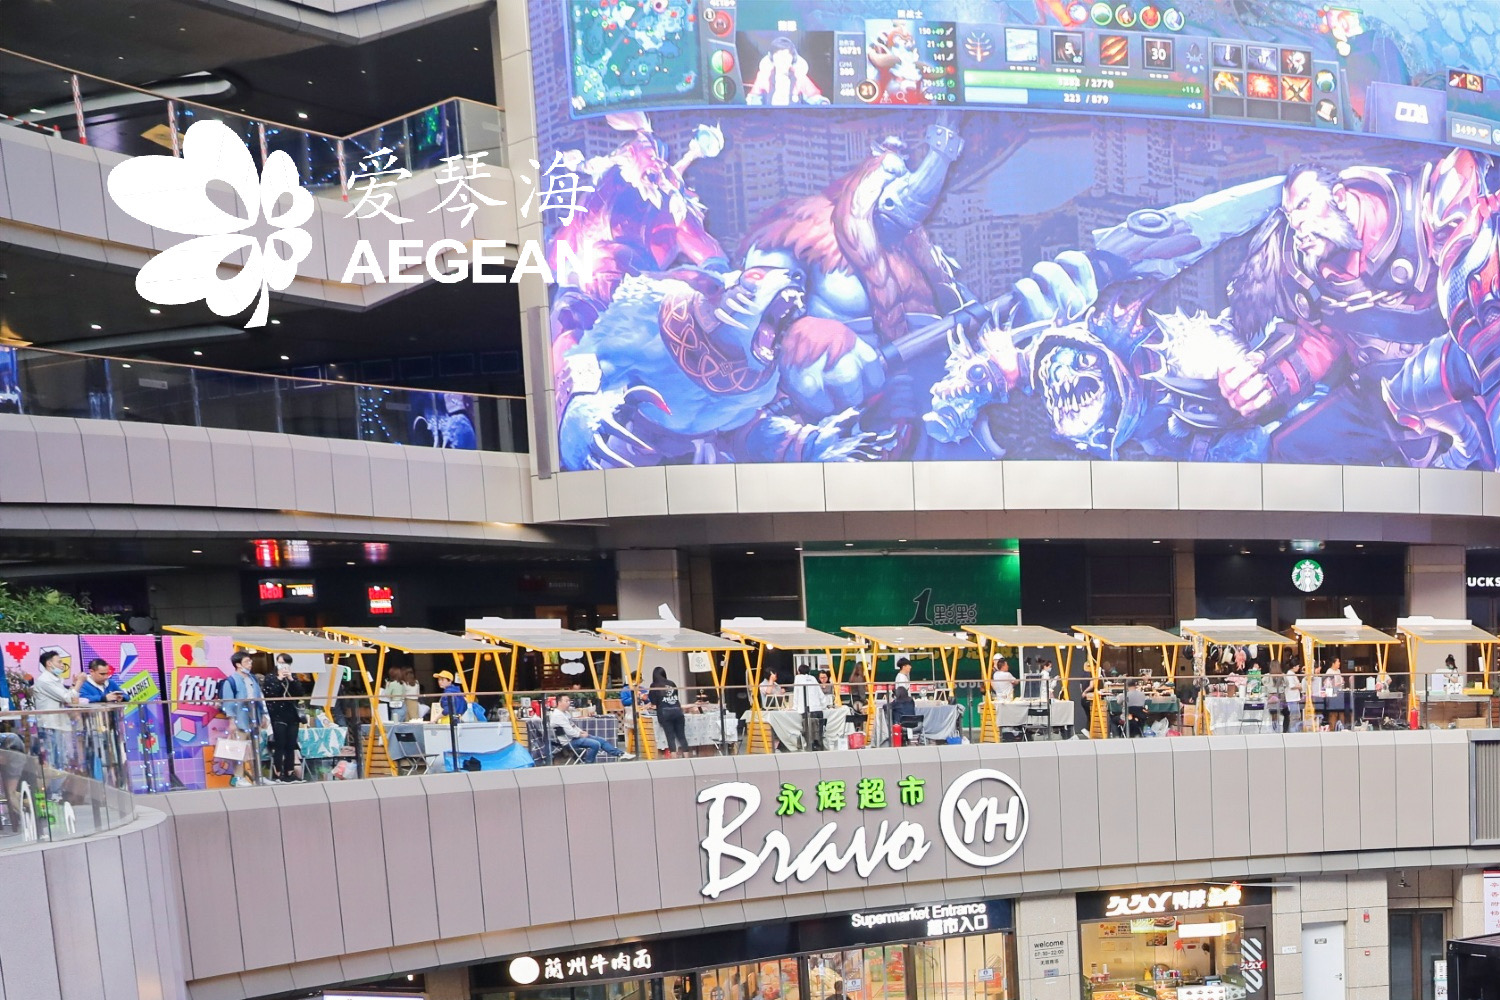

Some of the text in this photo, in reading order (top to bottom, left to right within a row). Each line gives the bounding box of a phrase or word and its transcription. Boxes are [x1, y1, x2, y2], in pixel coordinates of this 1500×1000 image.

[776, 775, 926, 816] 永辉超市
[697, 781, 931, 899] Bravo
[851, 903, 987, 929] Supermarket Entrance
[926, 914, 989, 937] 超市入口
[1034, 938, 1064, 949] welcome
[544, 948, 653, 980] 蘭州牛肉面
